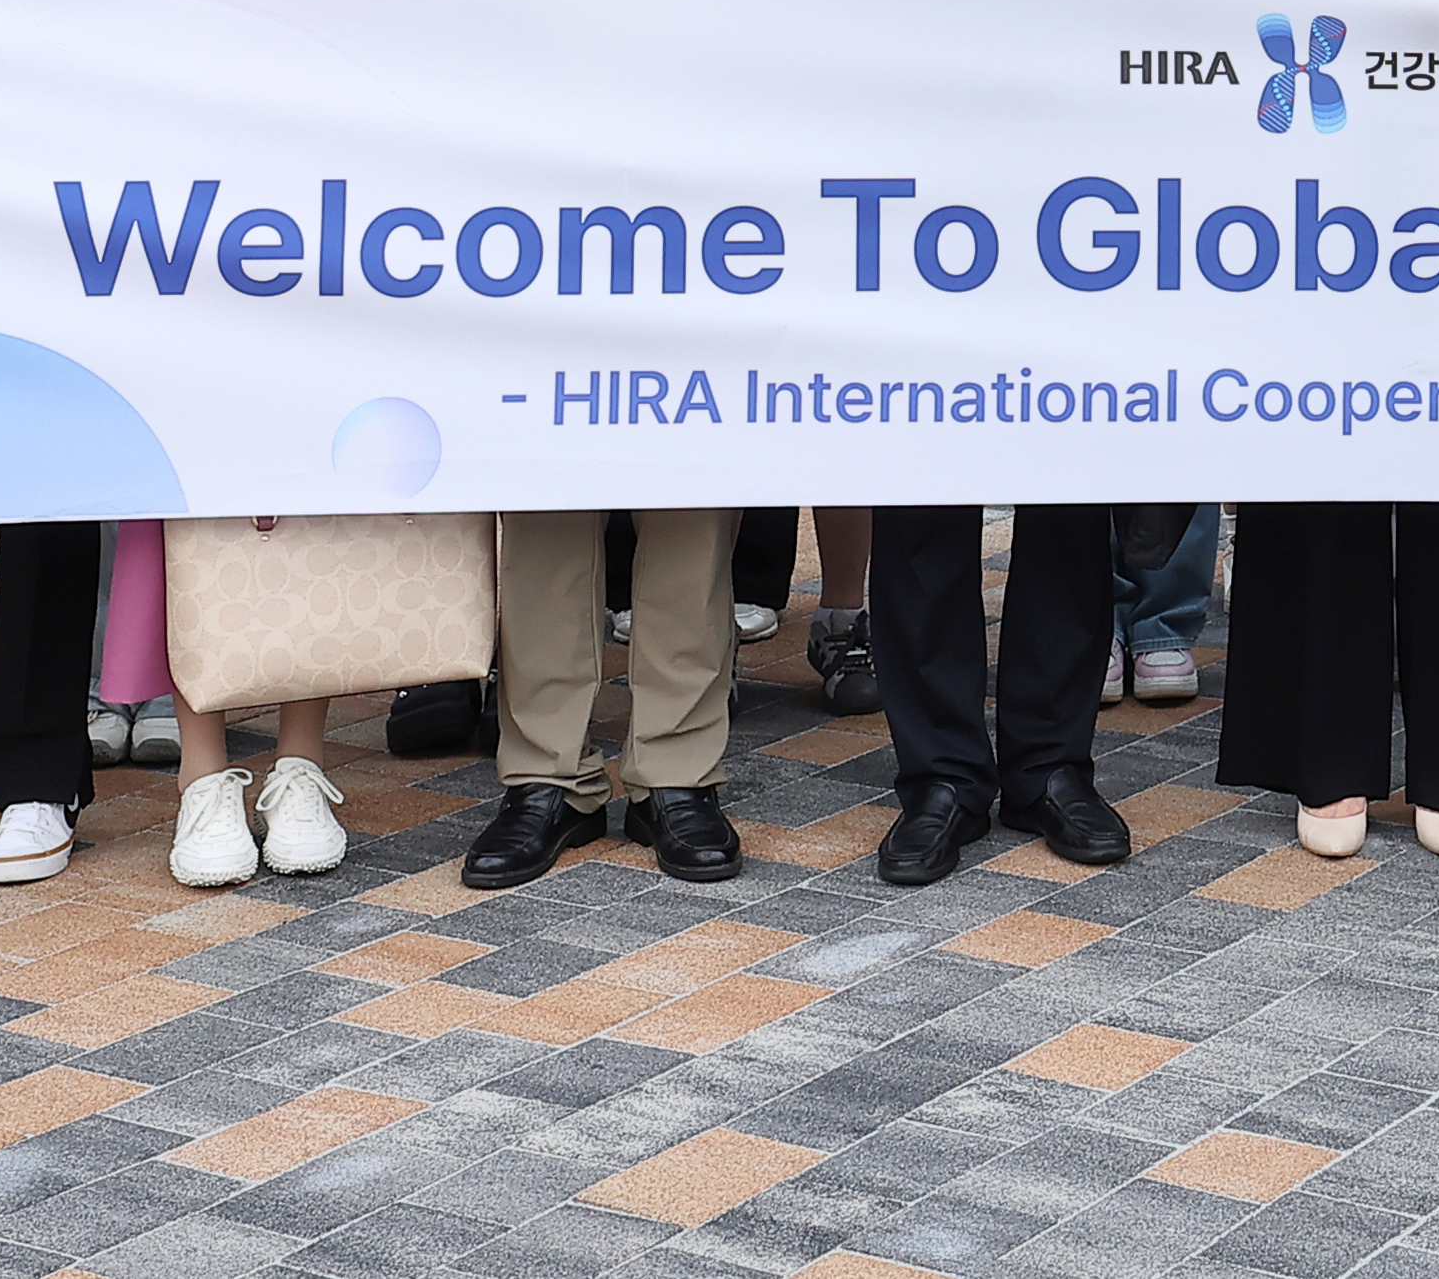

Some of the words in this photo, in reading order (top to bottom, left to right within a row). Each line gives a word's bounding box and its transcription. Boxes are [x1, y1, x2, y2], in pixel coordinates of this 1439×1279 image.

[1119, 50, 1239, 85] HIRA
[53, 179, 785, 299] Welcome
[820, 178, 999, 293] To
[553, 369, 722, 426] HIRA
[746, 367, 1177, 425] International
